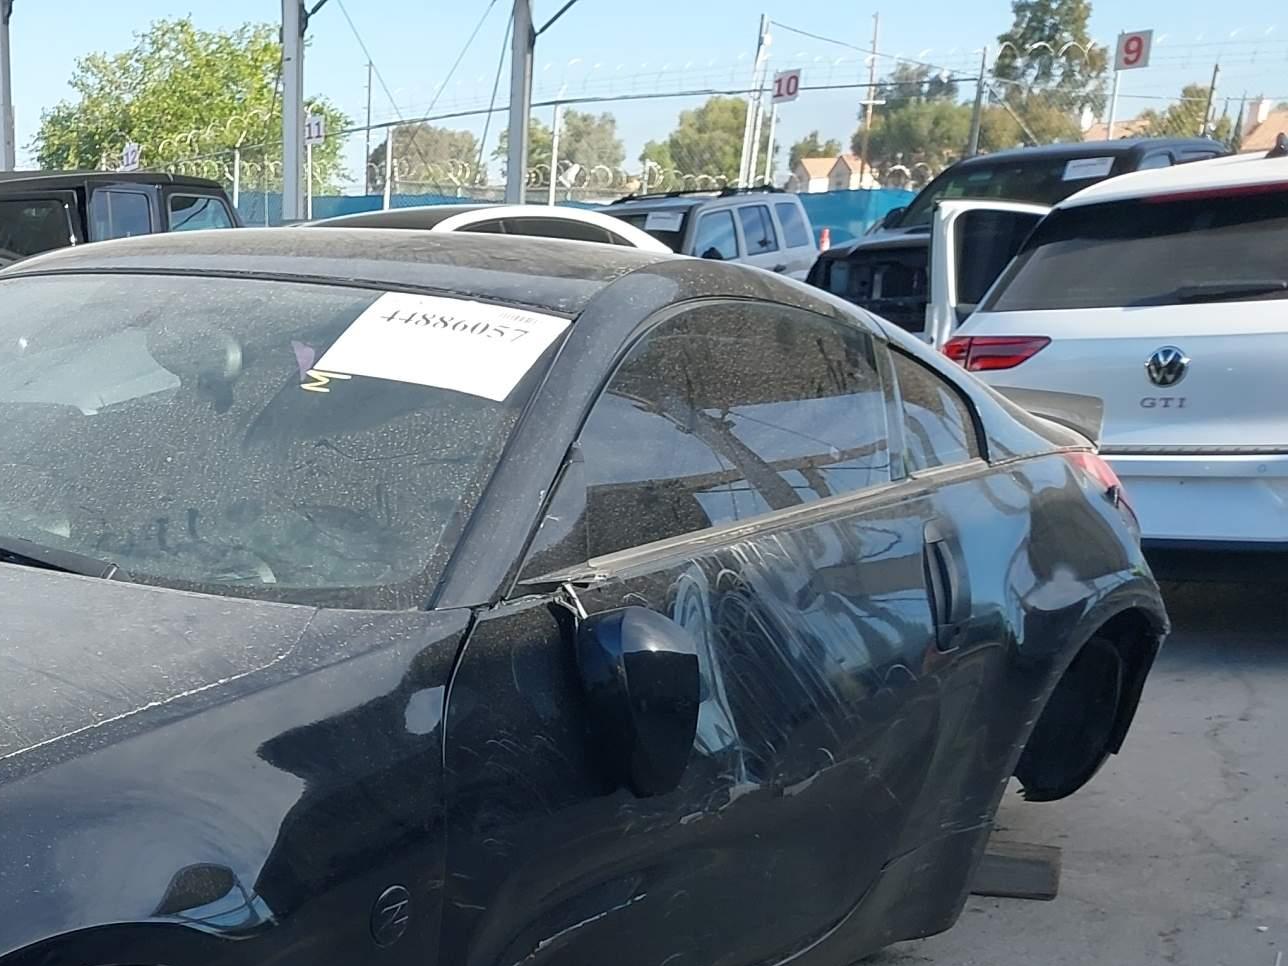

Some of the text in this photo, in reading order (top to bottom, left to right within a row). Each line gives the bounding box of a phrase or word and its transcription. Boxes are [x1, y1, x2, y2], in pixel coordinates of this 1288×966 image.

[1123, 35, 1144, 66] 9
[773, 74, 799, 98] 10
[304, 120, 323, 140] 11
[123, 149, 138, 168] 12
[380, 310, 530, 343] 44886057
[1139, 396, 1187, 409] GTI
